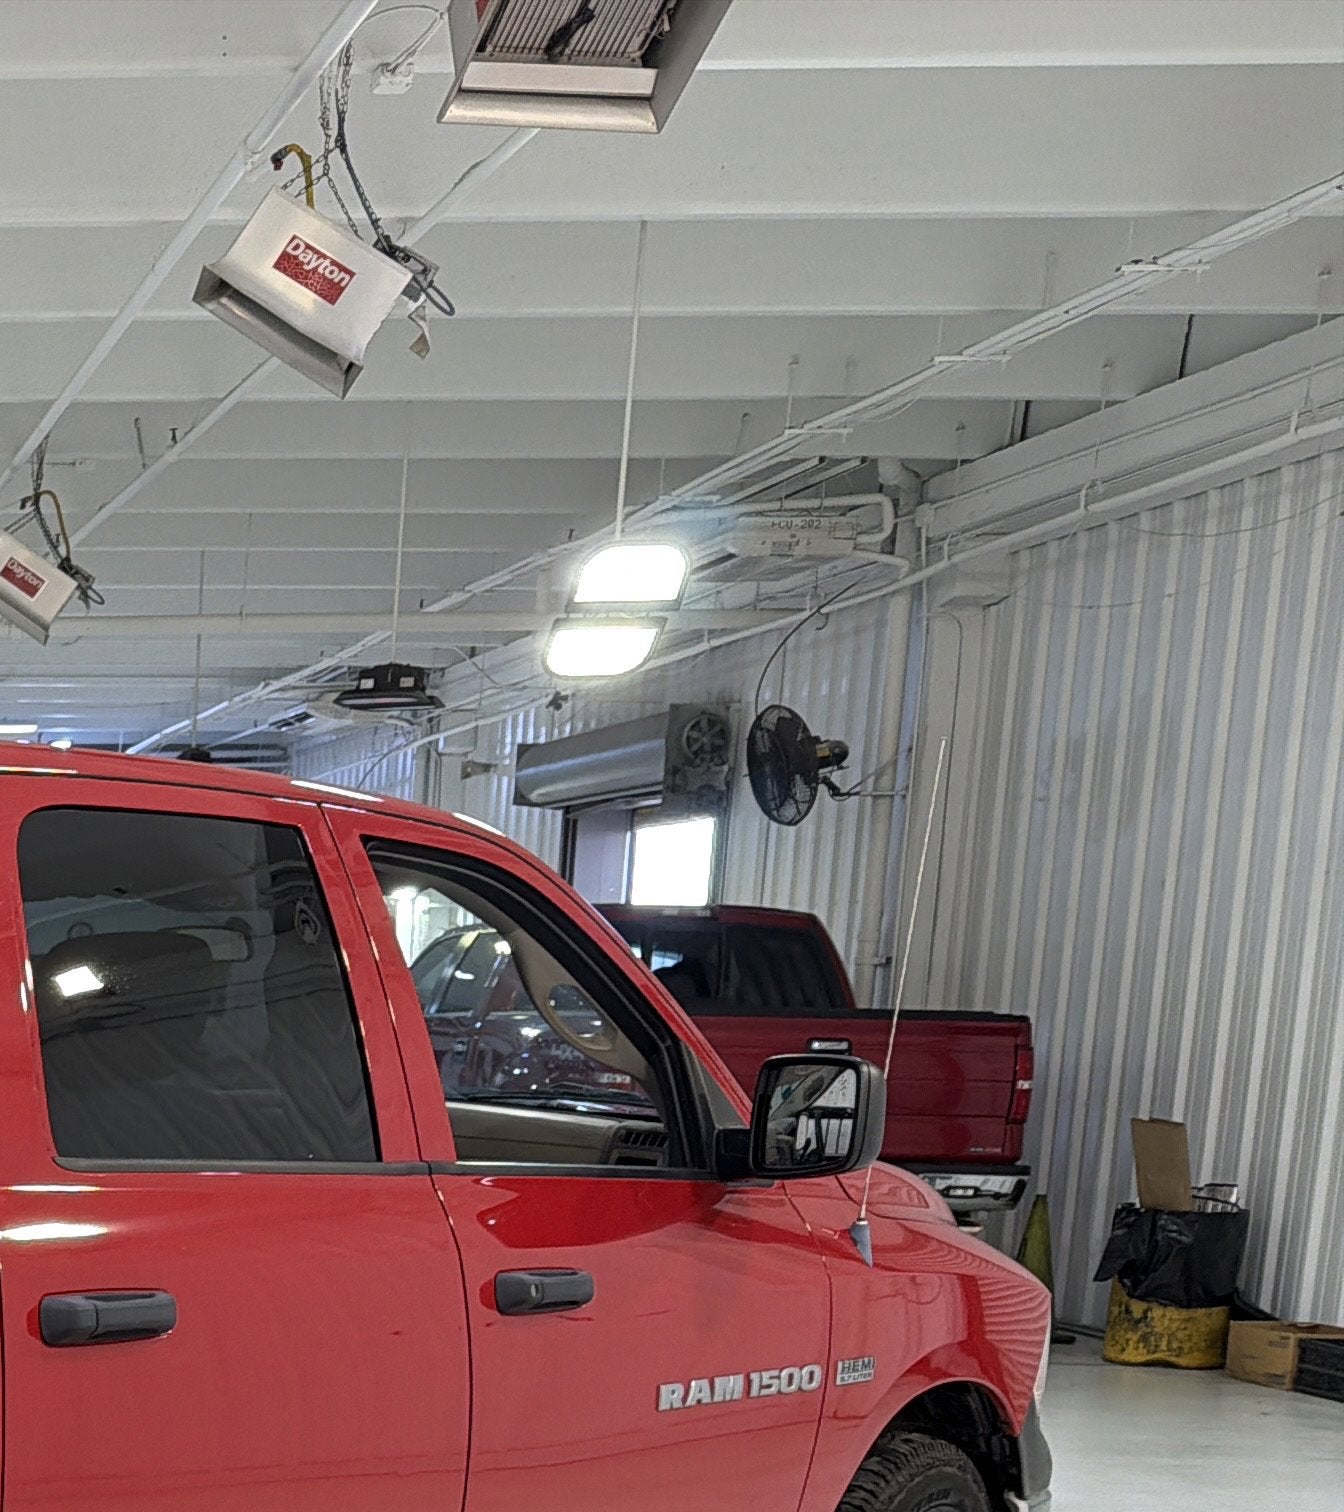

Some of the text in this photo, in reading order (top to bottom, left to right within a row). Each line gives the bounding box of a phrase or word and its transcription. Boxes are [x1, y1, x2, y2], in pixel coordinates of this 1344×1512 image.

[285, 237, 353, 288] Dayton
[657, 1363, 823, 1412] RAM 1500
[840, 1357, 876, 1375] HEMI
